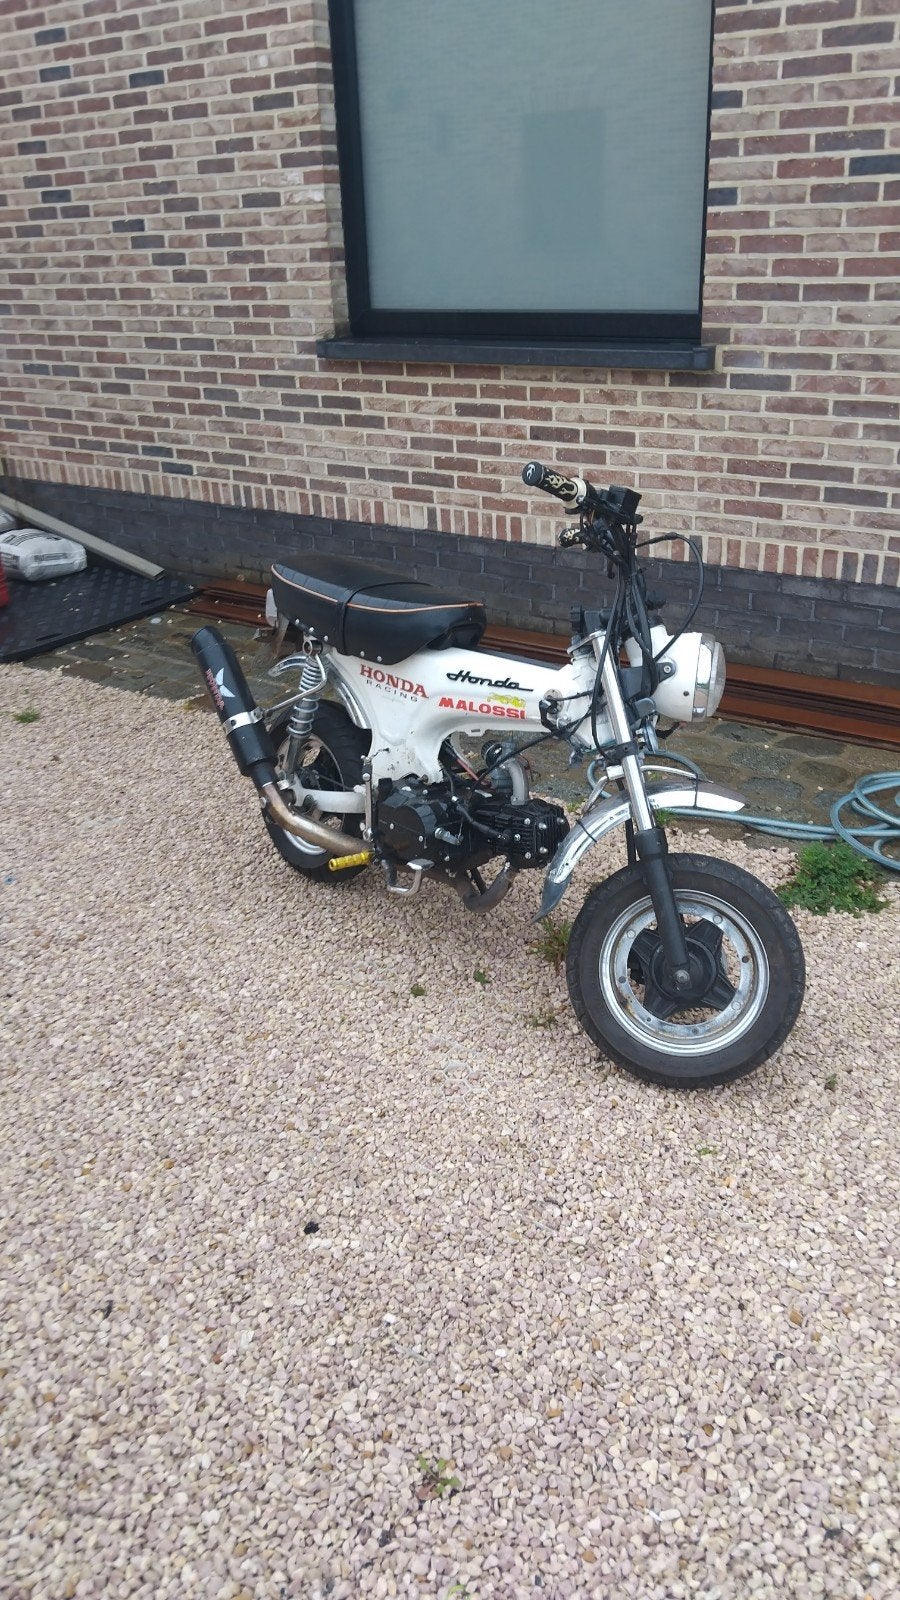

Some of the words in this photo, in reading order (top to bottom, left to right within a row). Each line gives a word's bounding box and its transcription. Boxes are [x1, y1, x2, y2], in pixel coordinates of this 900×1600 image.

[360, 664, 429, 698] HONDA
[366, 680, 418, 702] RACING
[446, 670, 534, 692] Honda
[438, 697, 526, 720] MALOSSI
